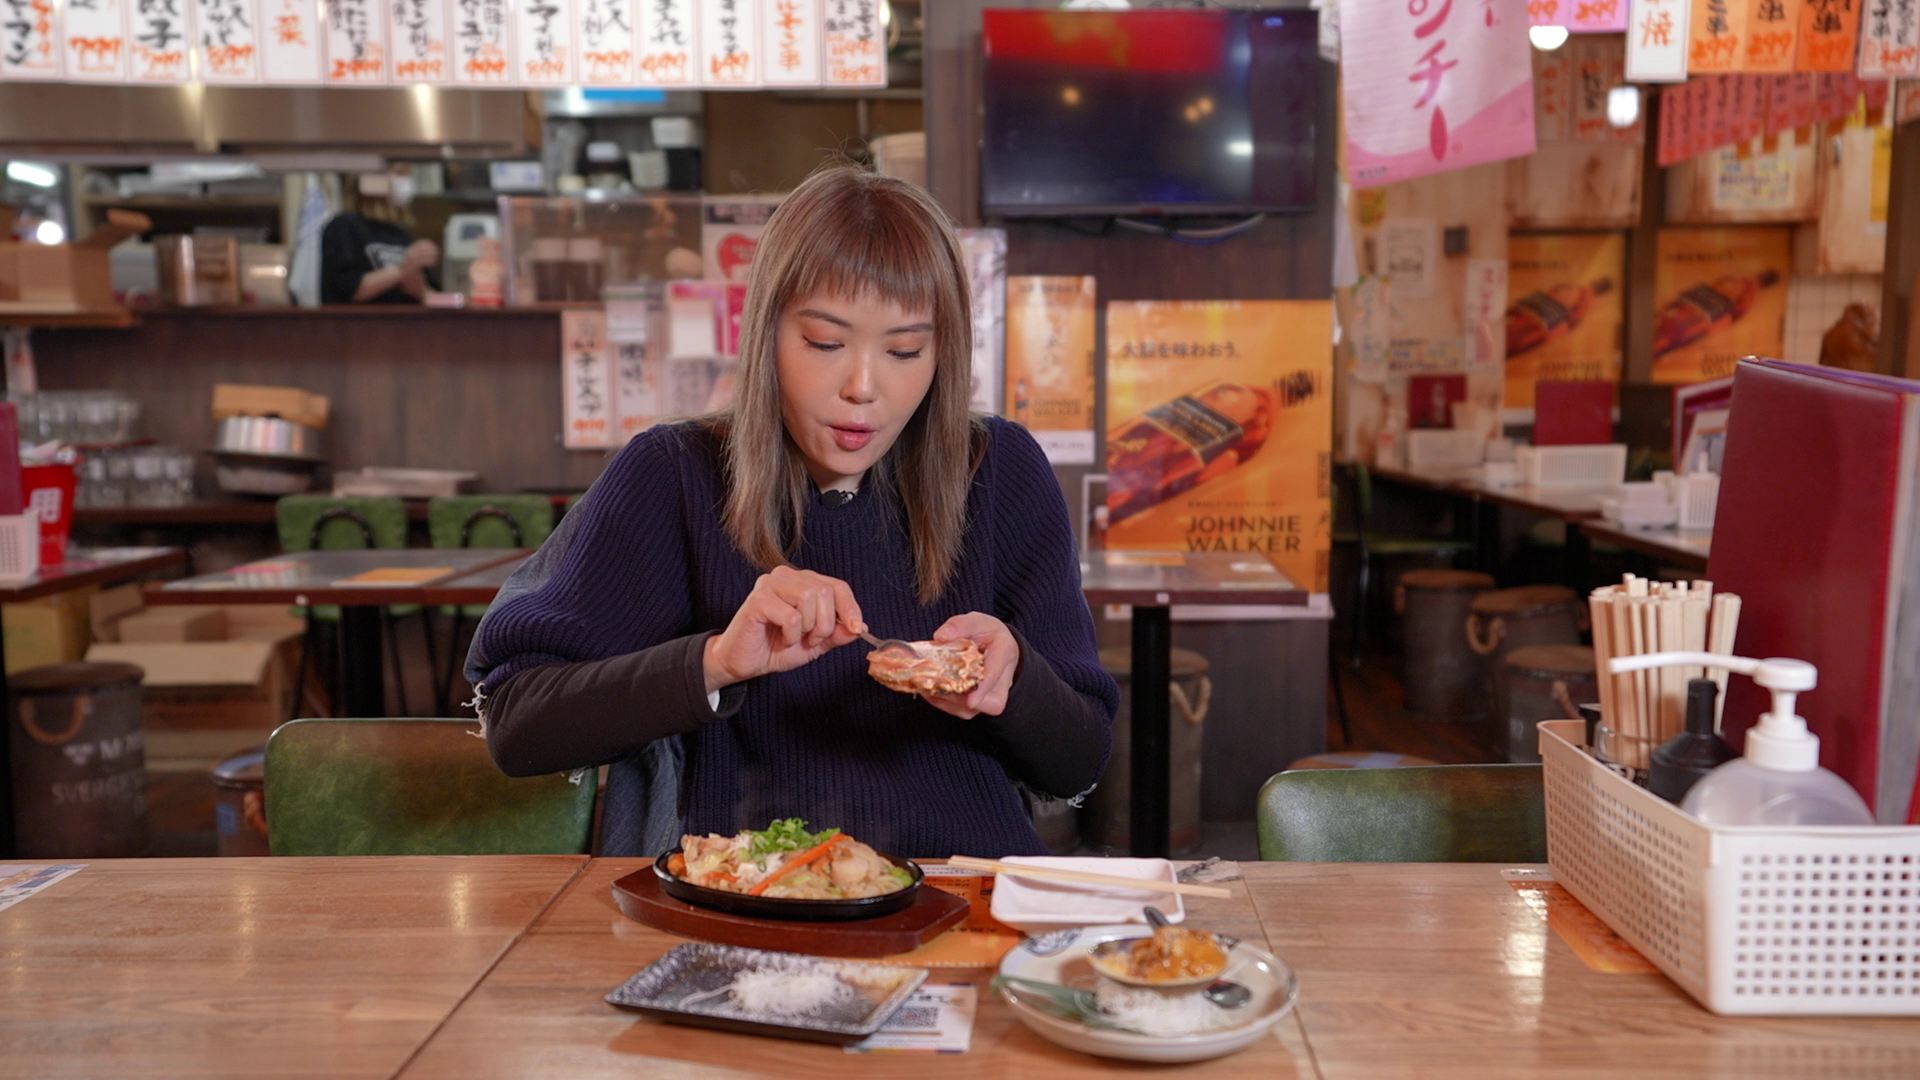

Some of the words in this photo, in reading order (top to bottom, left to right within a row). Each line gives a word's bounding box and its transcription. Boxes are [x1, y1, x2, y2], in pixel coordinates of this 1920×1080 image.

[1640, 0, 1675, 46] 焼
[1186, 515, 1302, 534] JOHNNIE
[1186, 535, 1301, 553] WALKER
